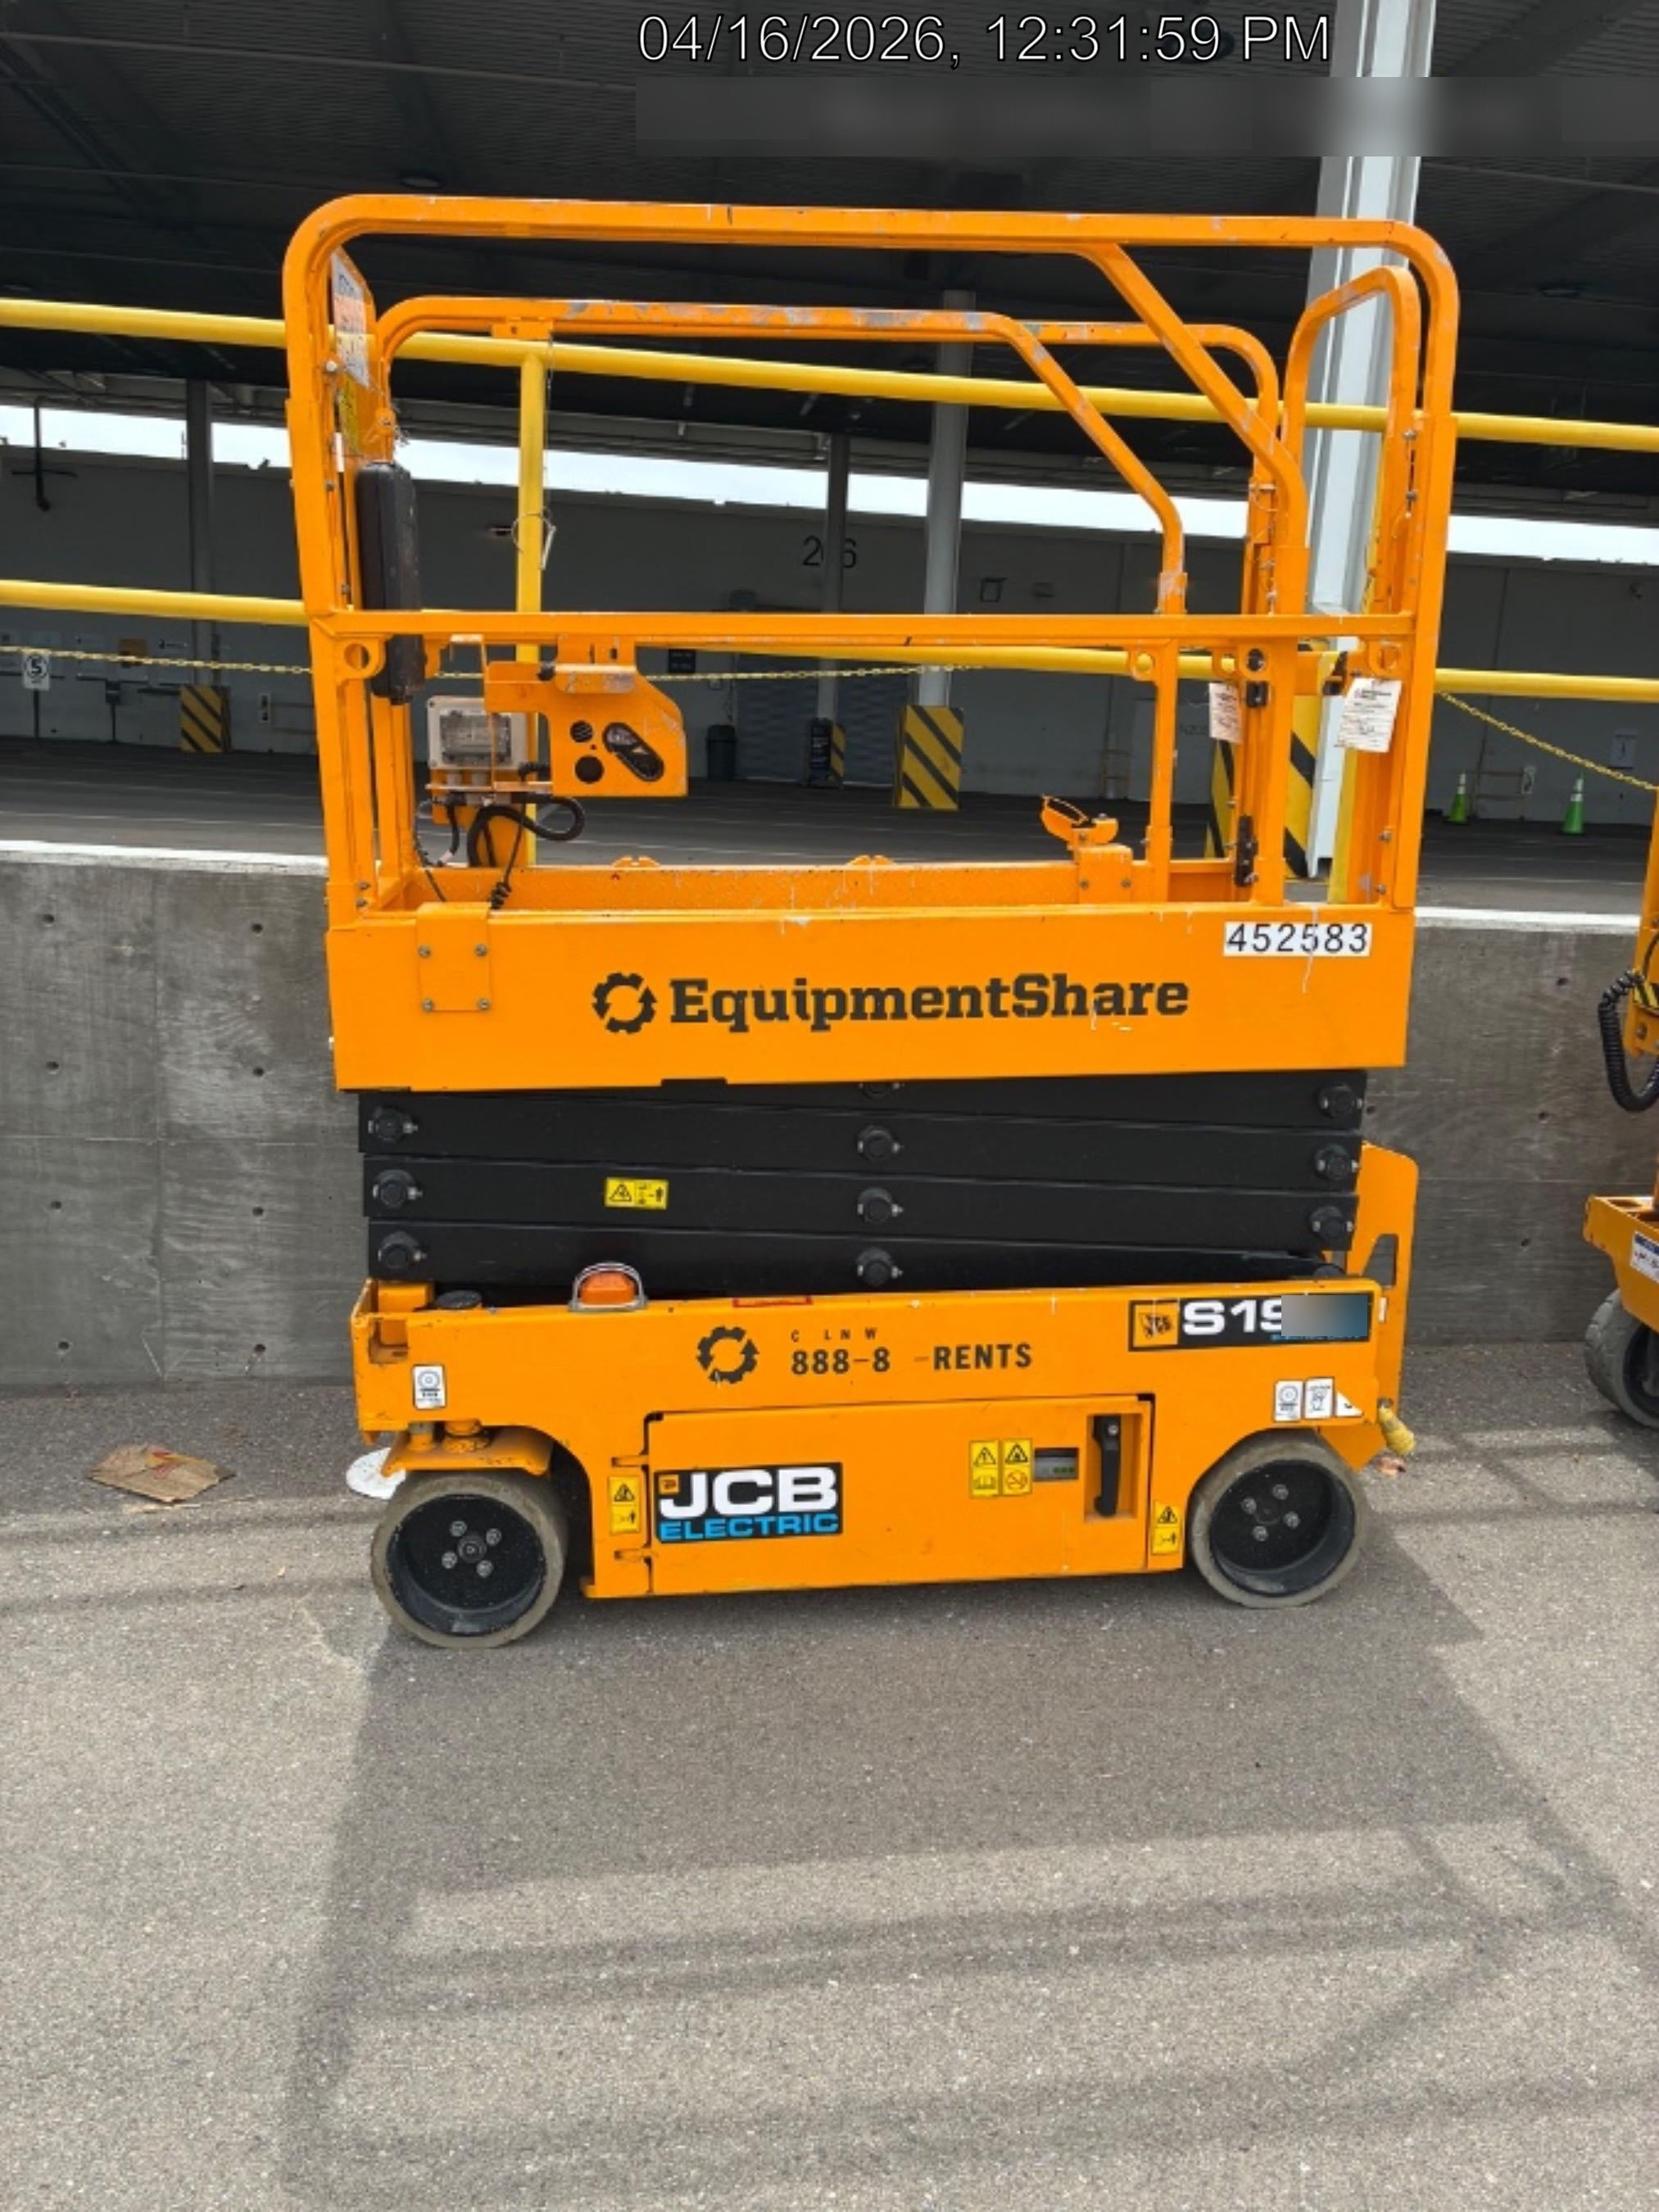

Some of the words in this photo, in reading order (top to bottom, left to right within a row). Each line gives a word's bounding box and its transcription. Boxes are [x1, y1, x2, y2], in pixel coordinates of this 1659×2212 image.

[803, 535, 856, 568] 26
[1226, 923, 1367, 953] 452583
[669, 973, 1189, 1032] EquipmentShare
[659, 1466, 839, 1520] JCB
[659, 1513, 840, 1543] ELECTRIC
